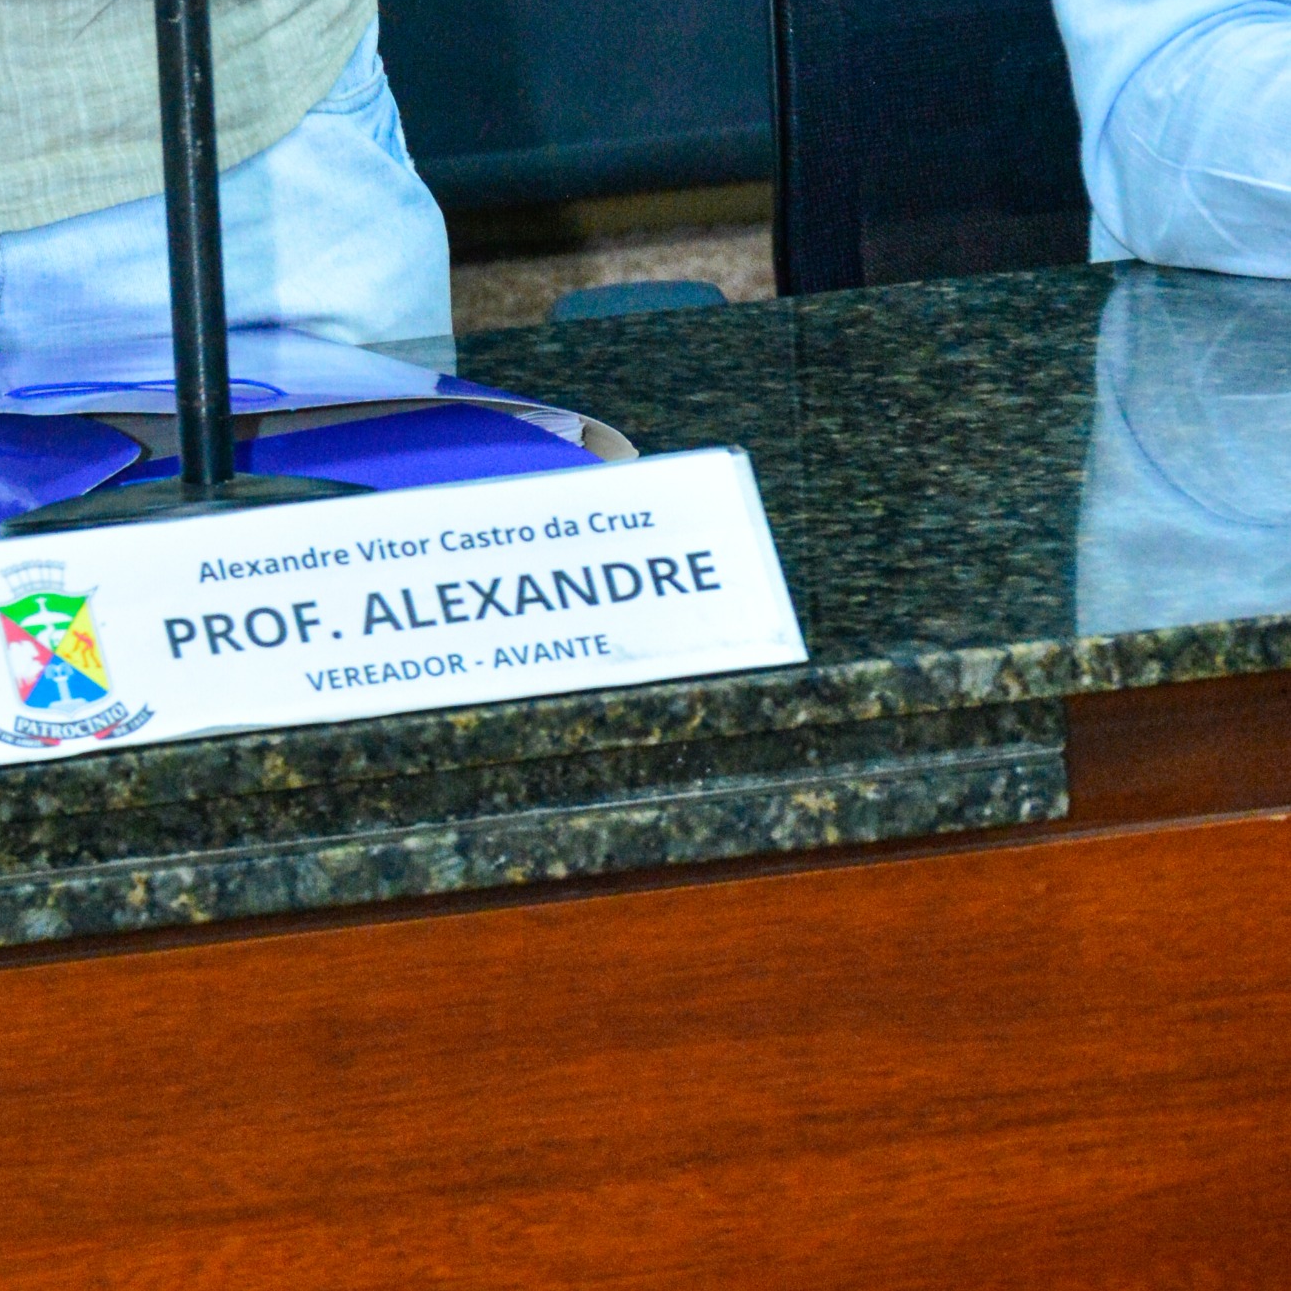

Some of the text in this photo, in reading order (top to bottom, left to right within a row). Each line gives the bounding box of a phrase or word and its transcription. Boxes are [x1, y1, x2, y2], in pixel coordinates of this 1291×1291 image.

[199, 511, 654, 584] Alexandre Vitor Castro da Cruz
[164, 549, 722, 660] PROF. ALEXANDRE
[305, 653, 467, 692] VEREADOR
[494, 634, 610, 669] AVANTE
